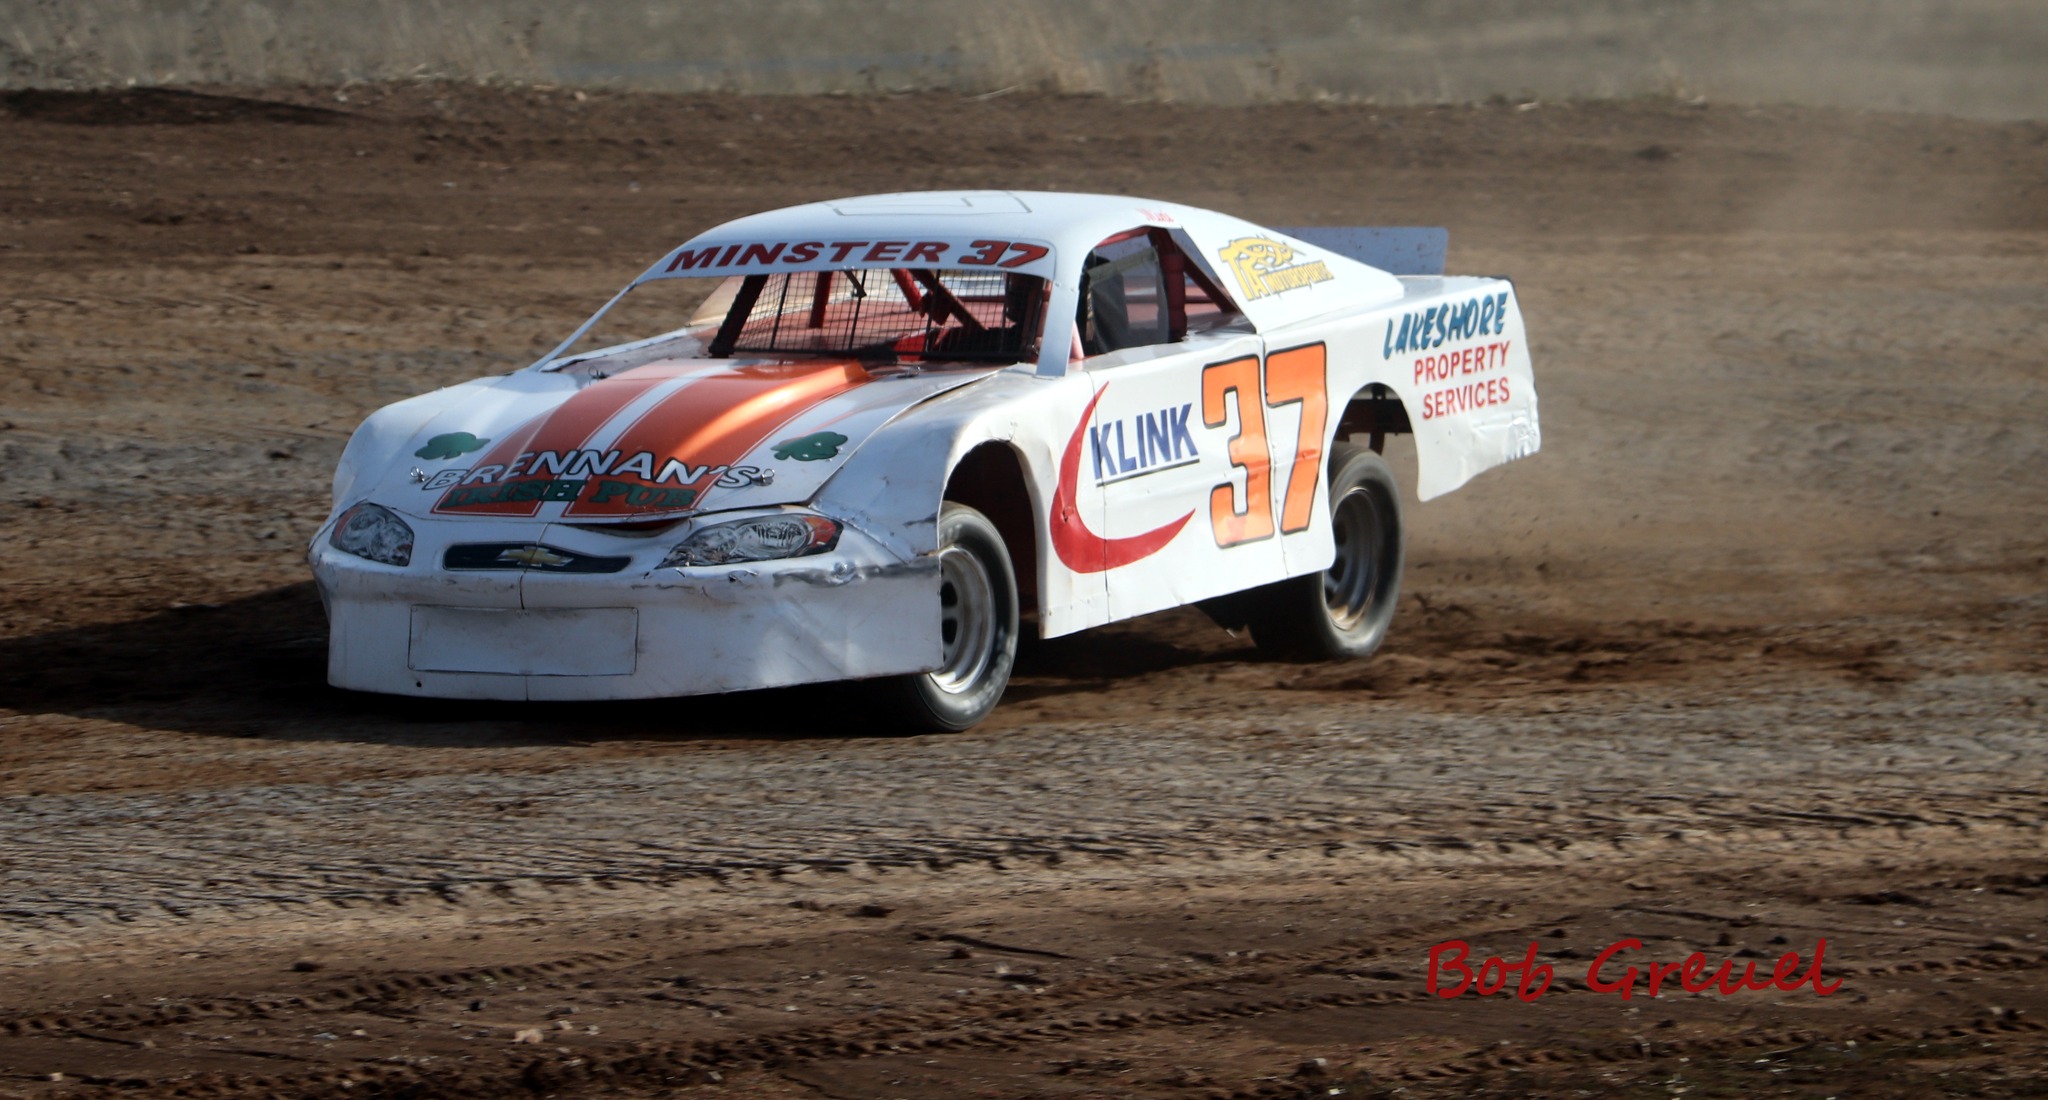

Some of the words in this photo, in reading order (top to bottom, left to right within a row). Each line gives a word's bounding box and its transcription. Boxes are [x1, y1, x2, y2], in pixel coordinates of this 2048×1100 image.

[663, 241, 950, 273] MINSTER
[958, 239, 1050, 268] 37
[1383, 291, 1508, 360] LAKESHORE
[1414, 340, 1511, 386] PROPERTY
[1422, 376, 1511, 420] SERVICES
[1090, 402, 1199, 481] KLINK
[1201, 340, 1329, 550] 37
[422, 449, 762, 491] BRENNAN'S
[439, 479, 588, 508] IRISH
[589, 480, 698, 508] PUB
